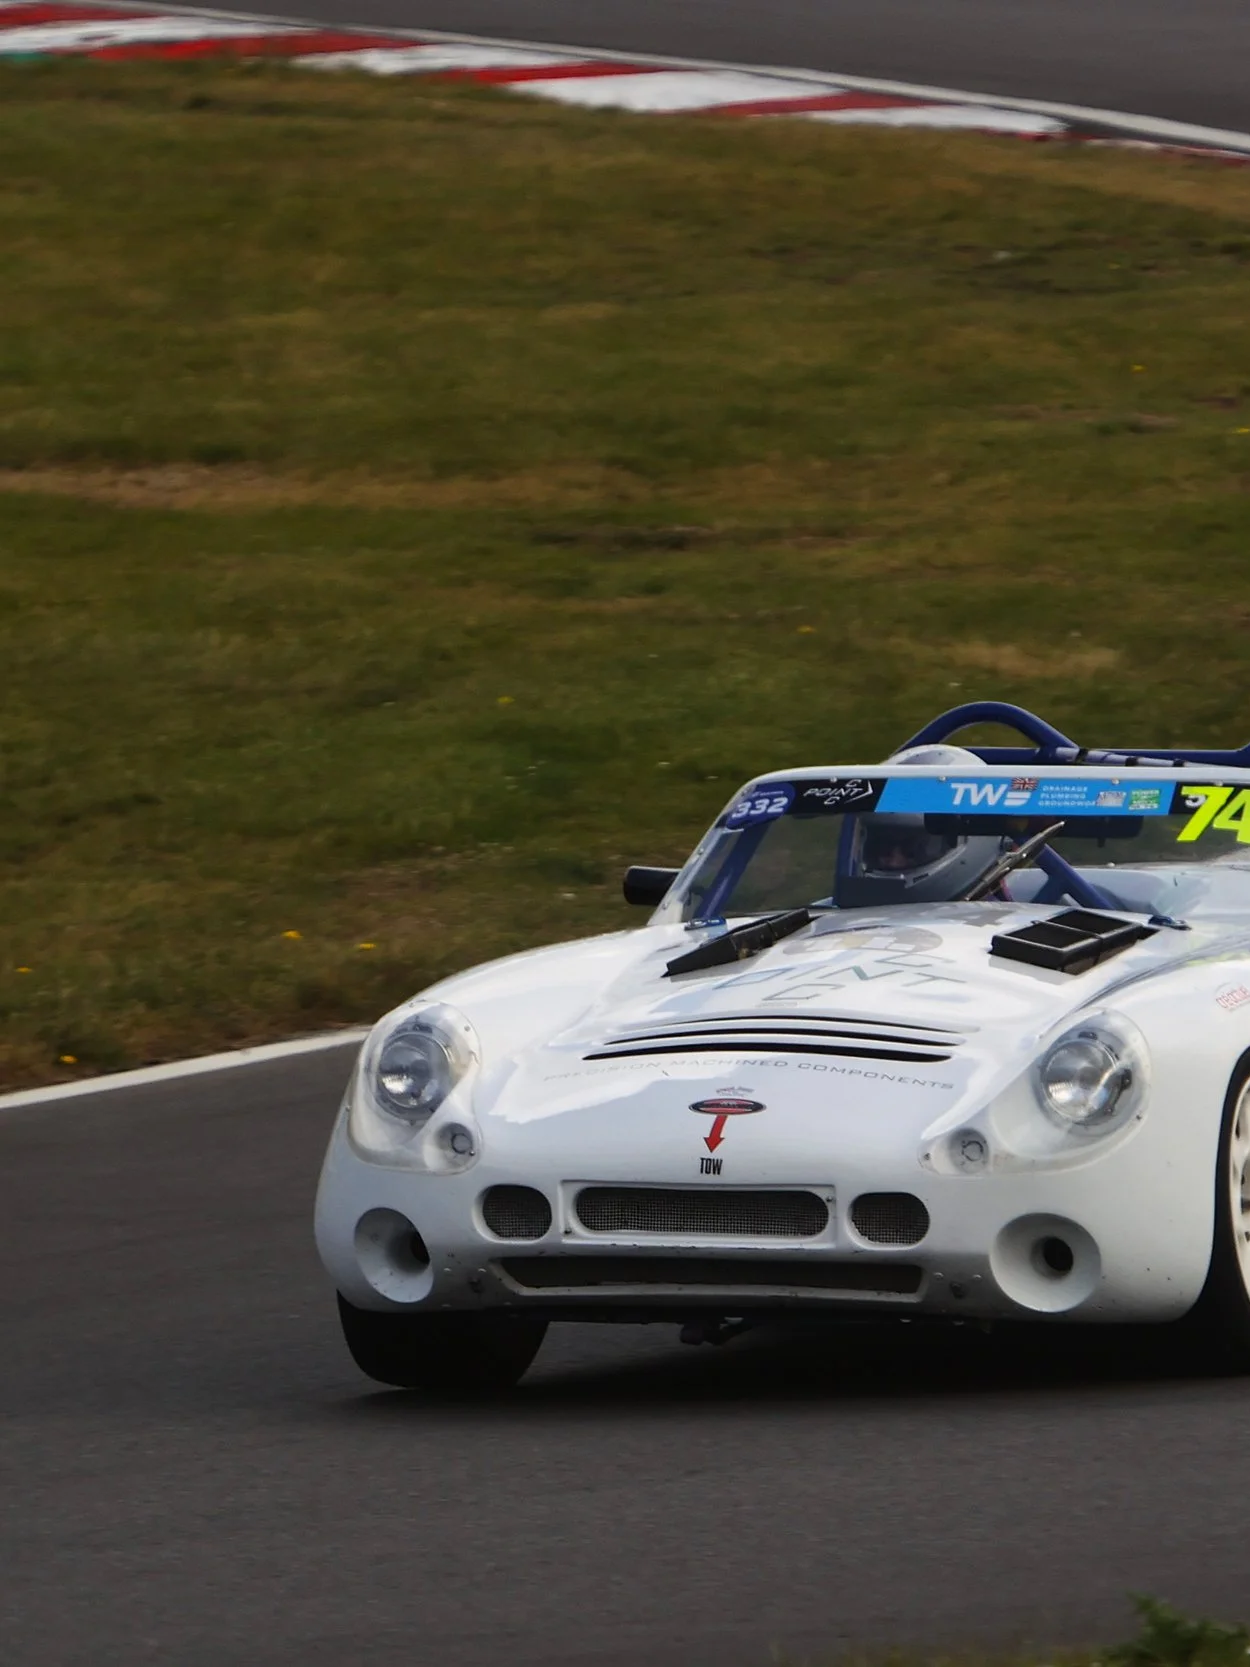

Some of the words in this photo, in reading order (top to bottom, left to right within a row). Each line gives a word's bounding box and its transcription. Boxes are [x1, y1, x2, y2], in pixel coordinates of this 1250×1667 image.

[803, 786, 864, 798] POINT
[731, 796, 789, 819] 332
[669, 1058, 789, 1068] MACHINED
[797, 1062, 955, 1090] COMPONENTS
[699, 1156, 723, 1175] TOW
